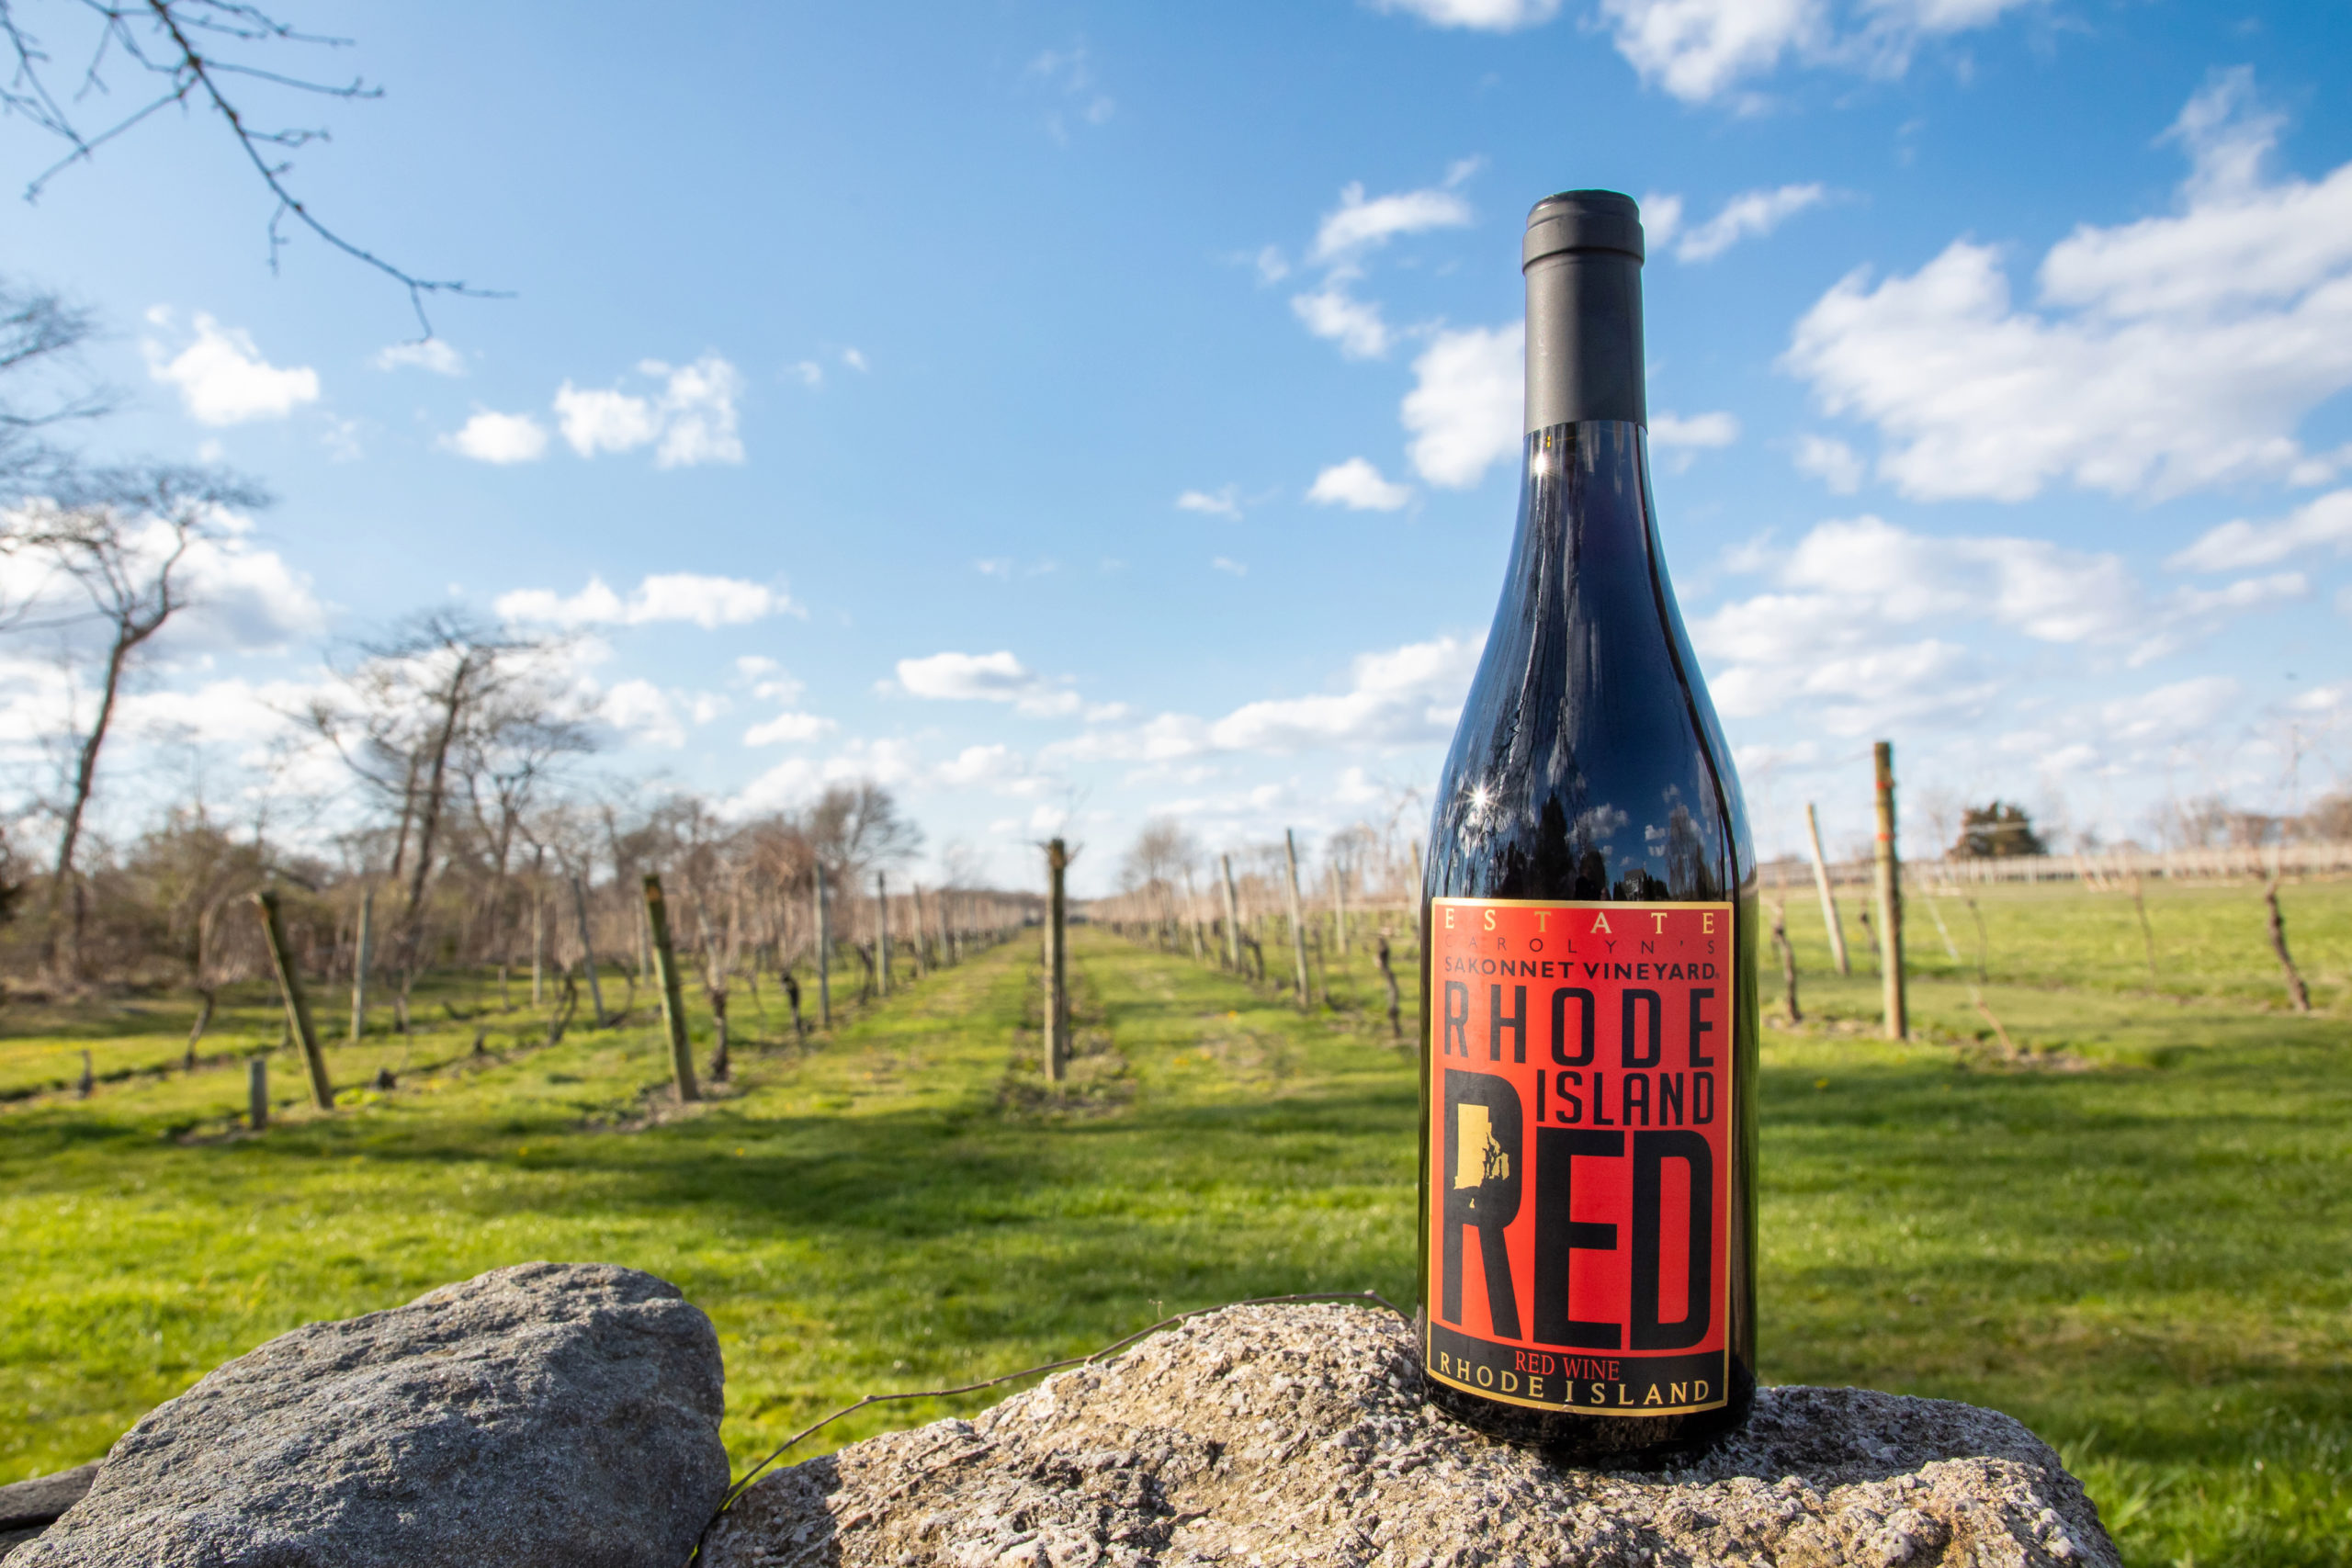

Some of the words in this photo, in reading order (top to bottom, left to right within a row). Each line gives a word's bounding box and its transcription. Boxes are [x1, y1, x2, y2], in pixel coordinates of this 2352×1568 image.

[1445, 908, 1714, 934] ESTATE
[1445, 934, 1715, 954] CAROLYN'S
[1445, 956, 1574, 978] SAKONNET
[1444, 980, 1714, 1068] RHODE
[1536, 1069, 1714, 1126] ISLAND
[1442, 1068, 1713, 1350] RED
[1440, 1351, 1544, 1398] RHODE
[1566, 1380, 1710, 1406] ISLAND
[1515, 1350, 1555, 1375] RED
[1564, 1357, 1620, 1381] WINE
